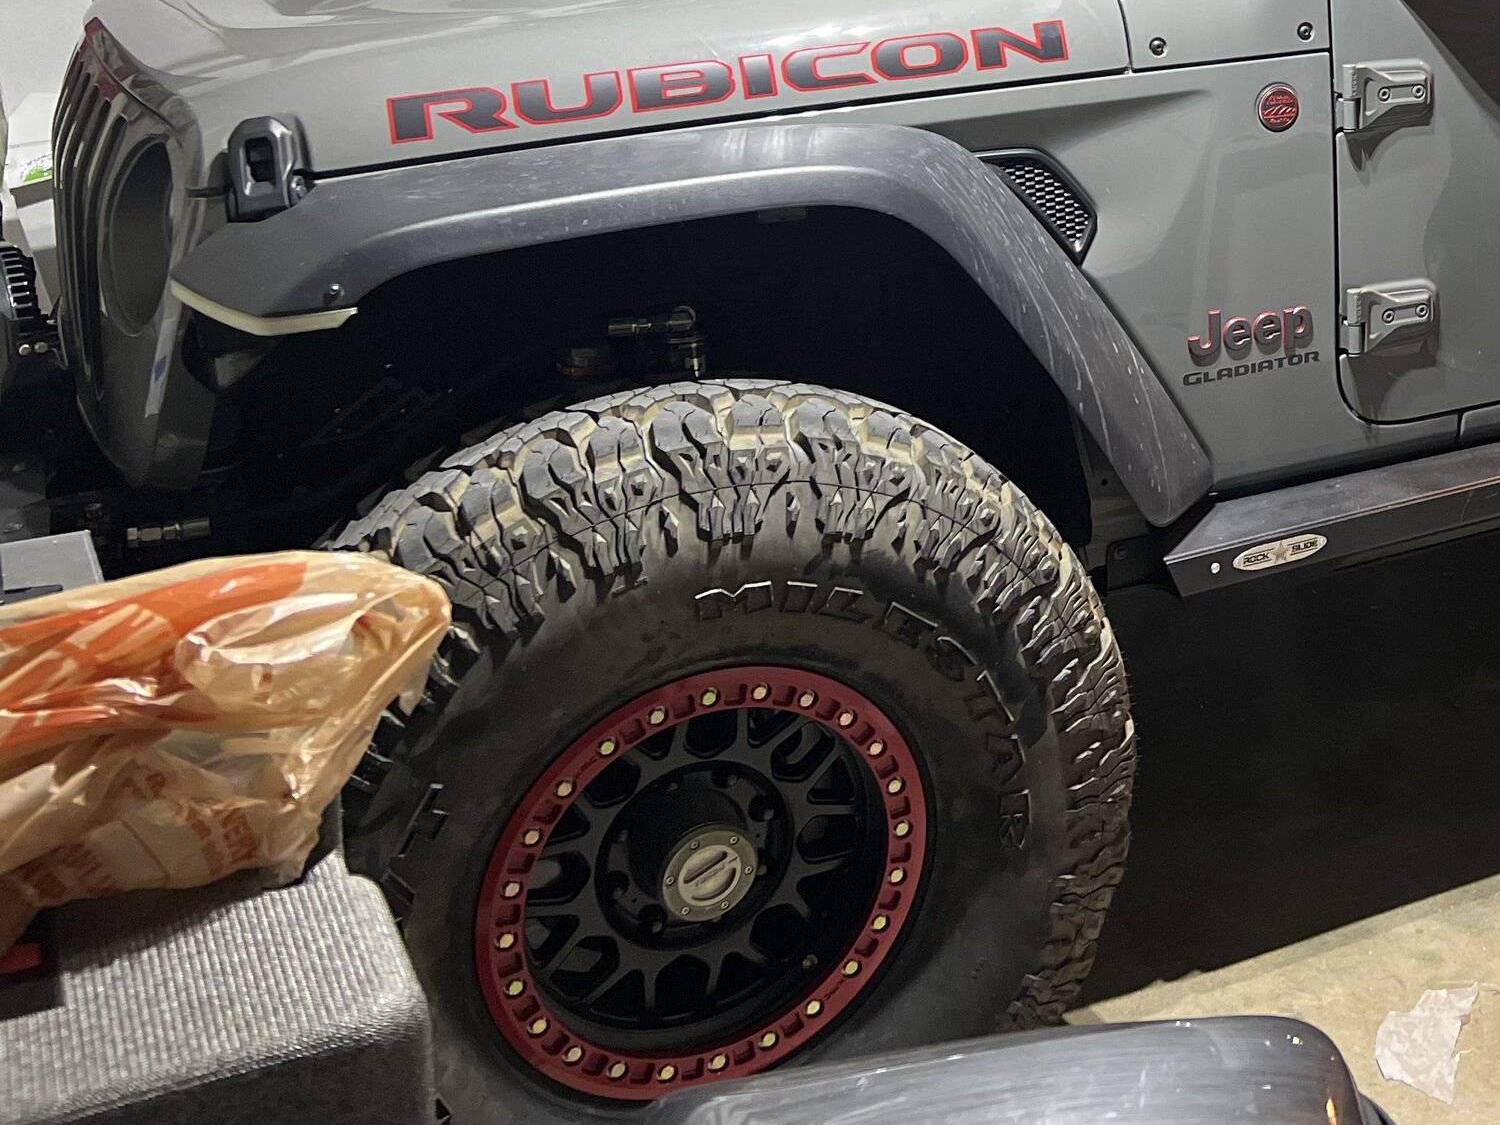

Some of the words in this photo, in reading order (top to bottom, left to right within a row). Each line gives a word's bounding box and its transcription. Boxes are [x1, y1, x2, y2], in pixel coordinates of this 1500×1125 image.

[387, 19, 1070, 144] RUBICON
[1187, 305, 1314, 356] Jeep
[1182, 350, 1320, 386] GLADIATOR
[1243, 553, 1270, 565] ROCK
[1291, 539, 1318, 553] SLIDE
